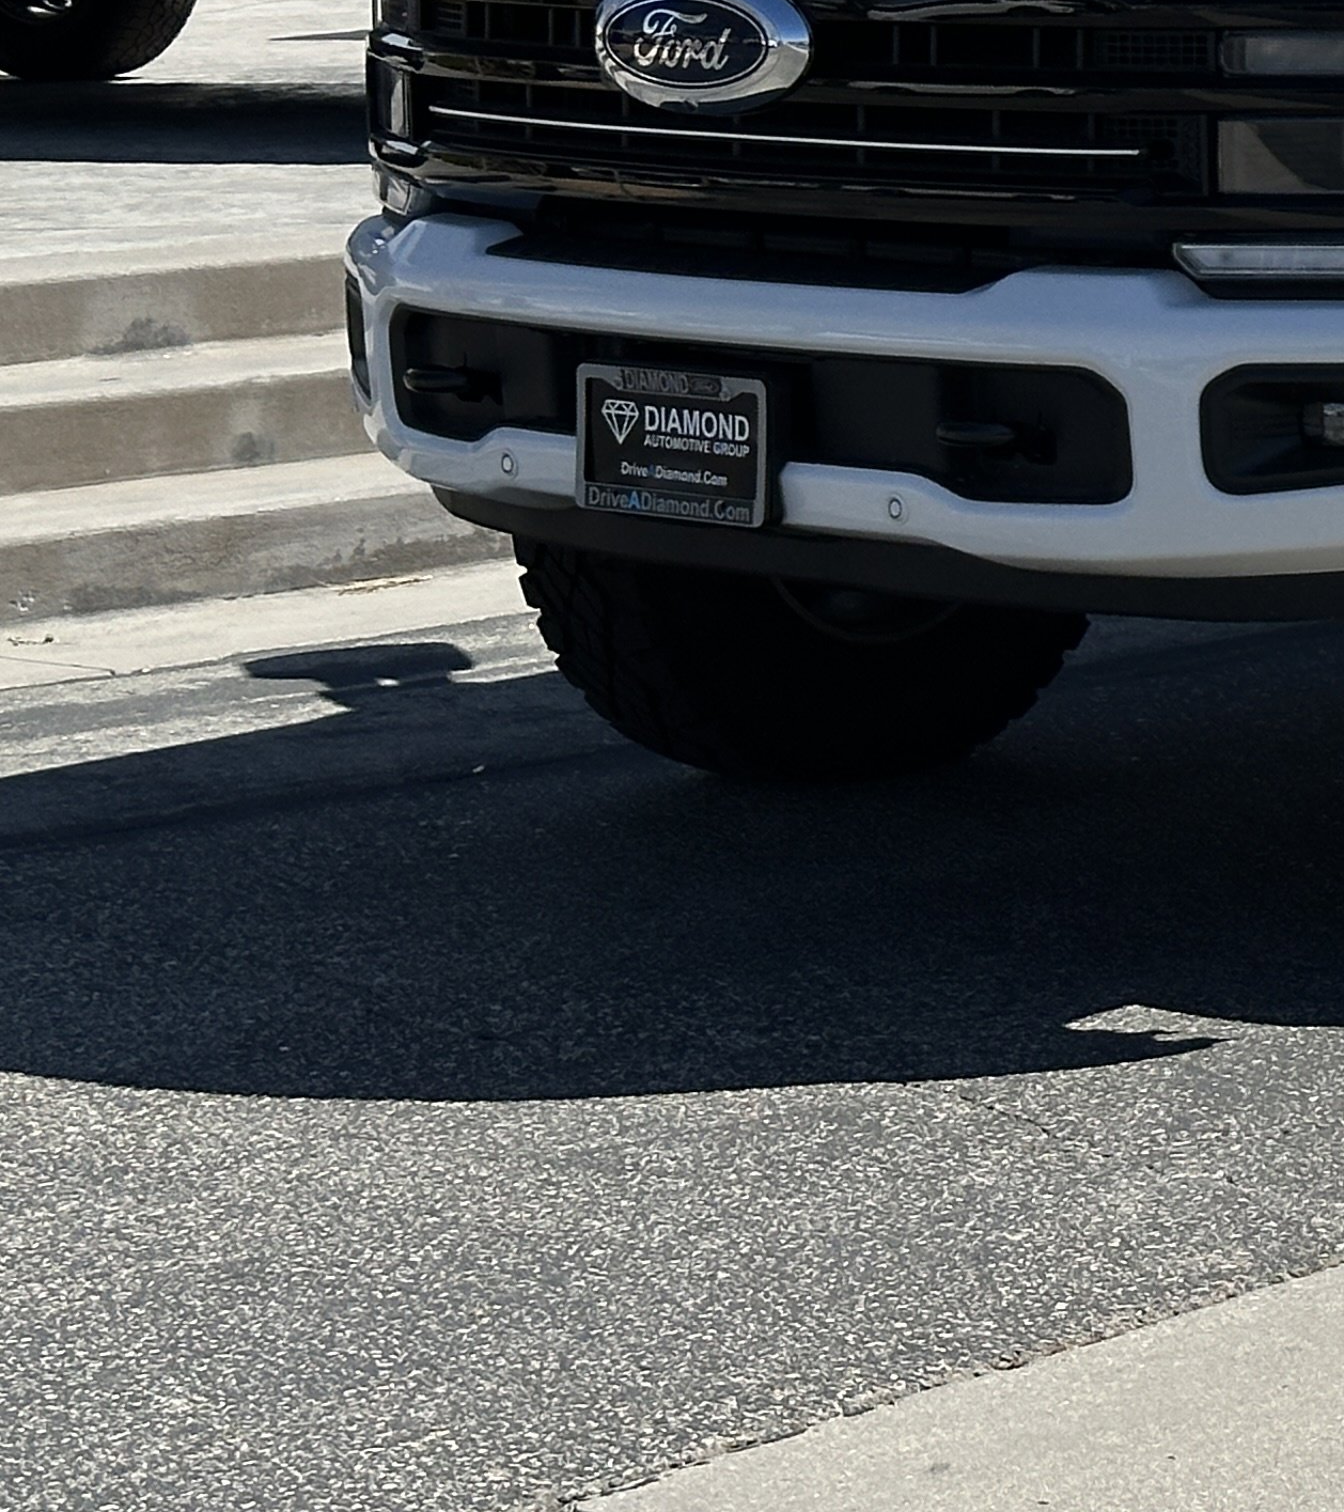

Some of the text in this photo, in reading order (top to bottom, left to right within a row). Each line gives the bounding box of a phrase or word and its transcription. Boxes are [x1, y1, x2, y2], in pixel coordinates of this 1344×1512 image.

[634, 8, 729, 72] Ford
[644, 405, 750, 442] DIAMOND
[644, 434, 750, 458] AUTOMOTIVE GROUP
[588, 486, 750, 522] DriveADiamond.Com
